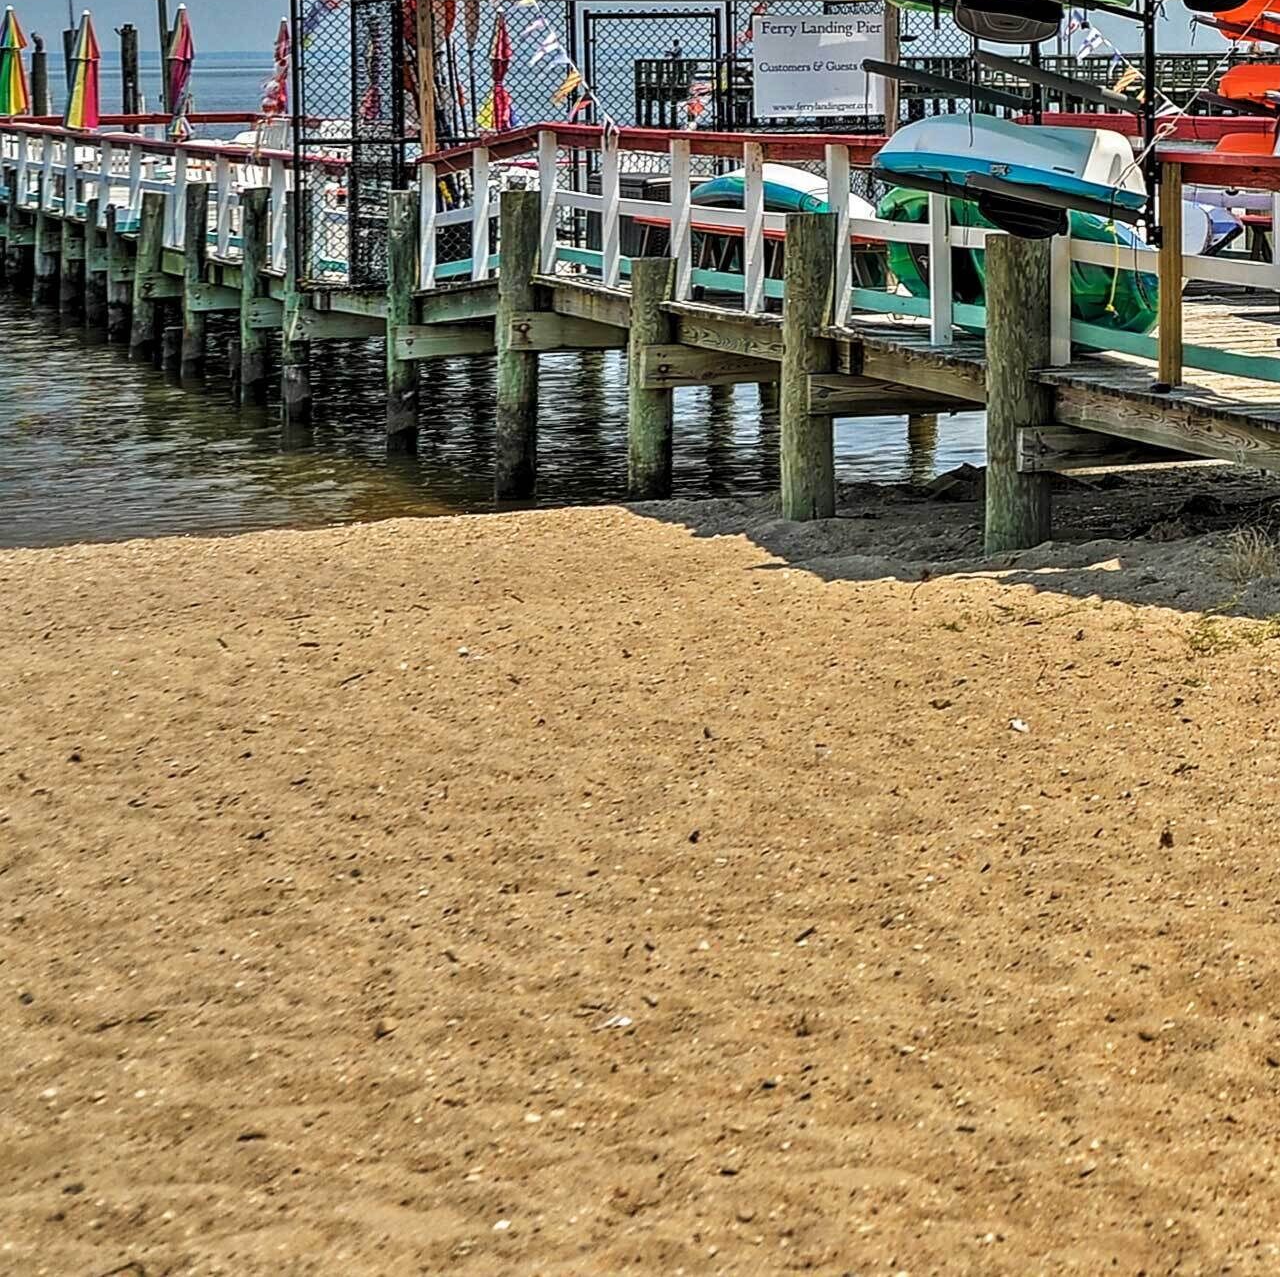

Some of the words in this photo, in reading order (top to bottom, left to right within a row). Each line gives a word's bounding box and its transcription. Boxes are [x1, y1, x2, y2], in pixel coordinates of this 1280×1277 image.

[761, 21, 797, 37] Ferry
[800, 21, 853, 37] Landing
[855, 21, 882, 34] Pier
[759, 62, 811, 72] Customers
[813, 61, 823, 72] &
[825, 61, 858, 71] Guests
